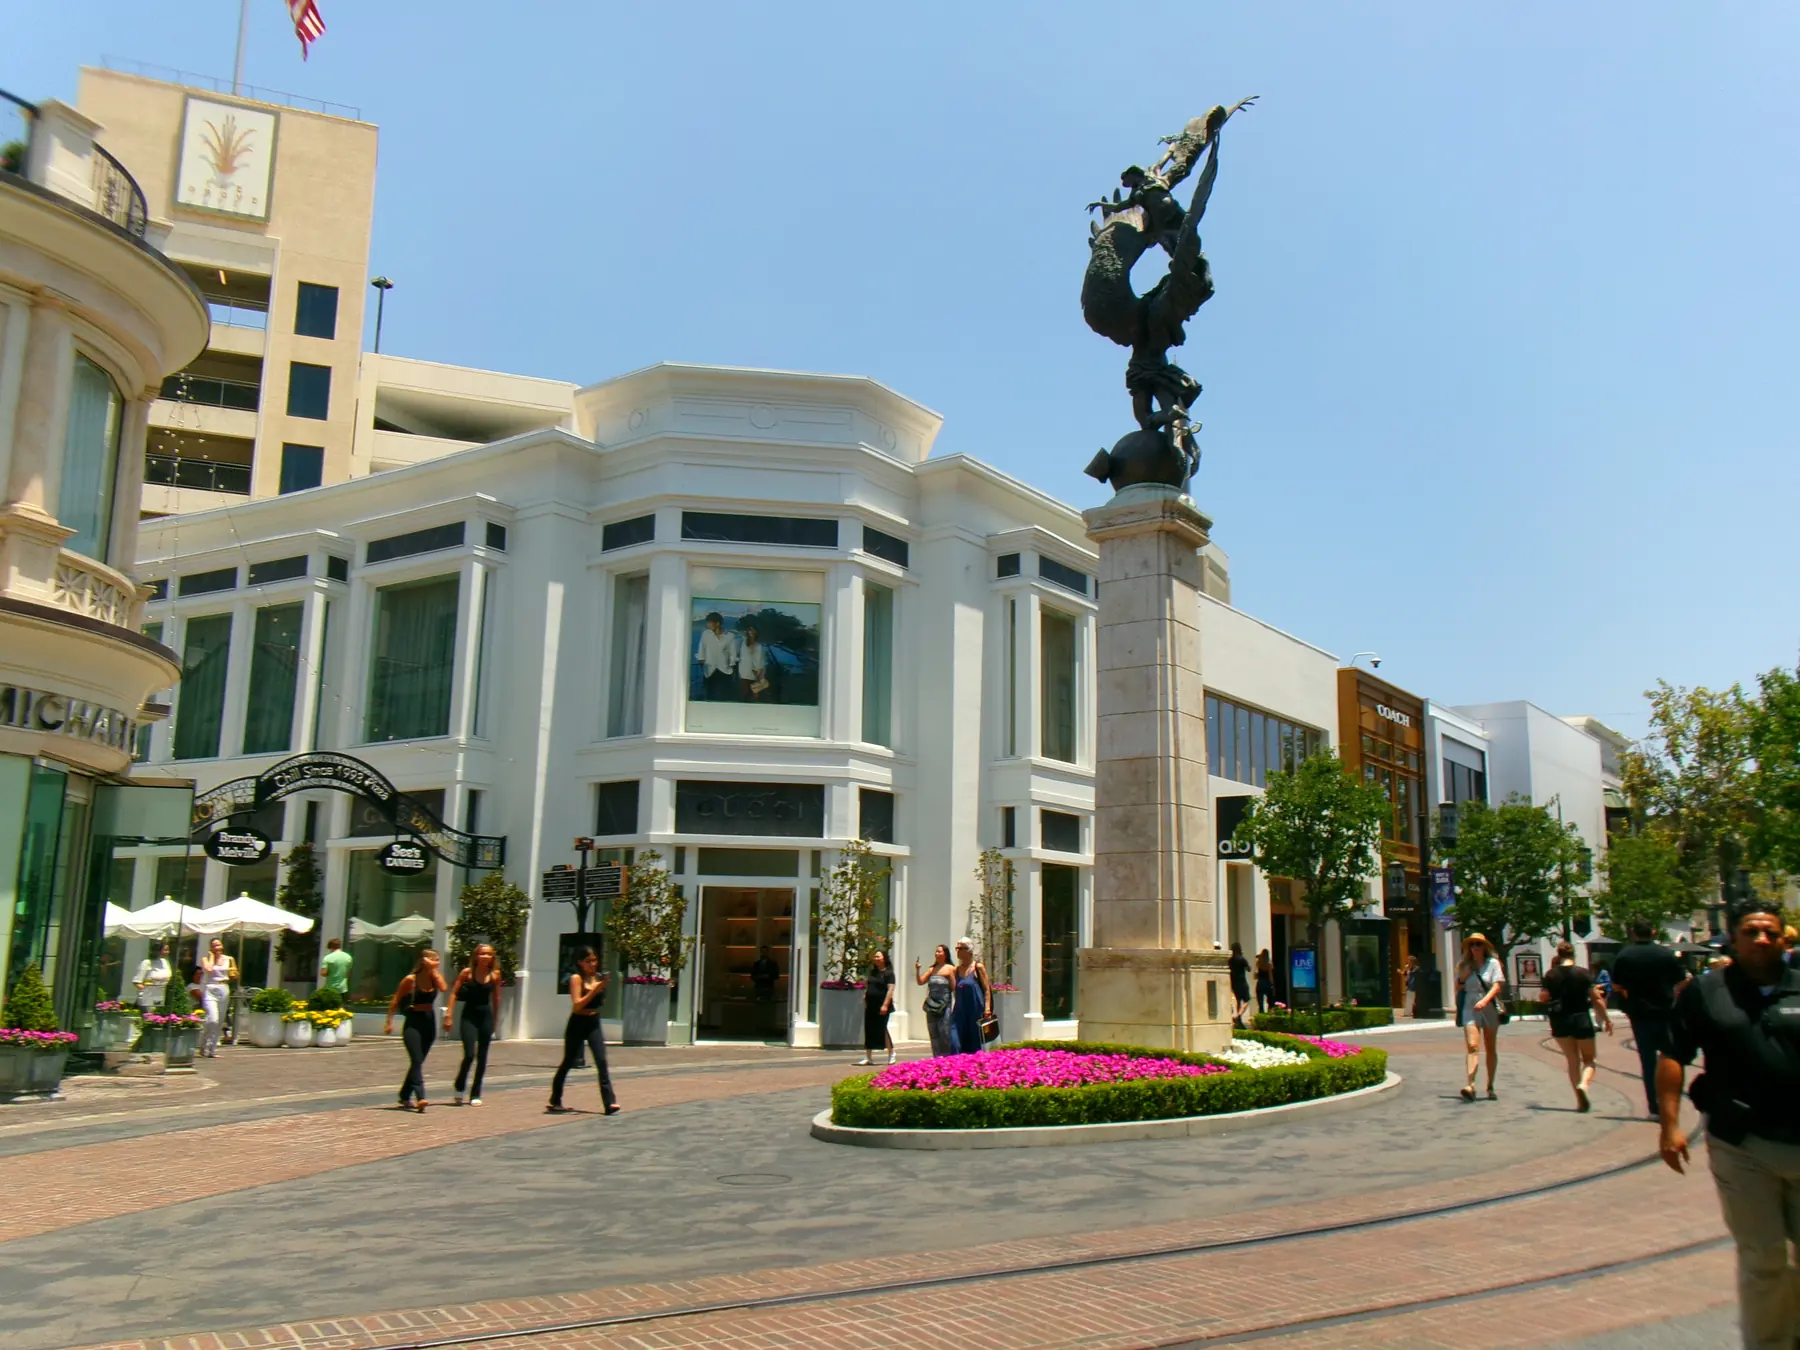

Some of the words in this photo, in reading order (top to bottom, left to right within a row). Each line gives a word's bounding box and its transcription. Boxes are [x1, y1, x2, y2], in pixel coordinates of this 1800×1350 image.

[1376, 704, 1410, 728] COACH
[274, 767, 301, 787] Chill
[303, 765, 334, 778] Since
[335, 765, 364, 784] 1993
[219, 832, 258, 847] Brandy
[217, 846, 260, 859] Melville
[391, 844, 421, 858] See's
